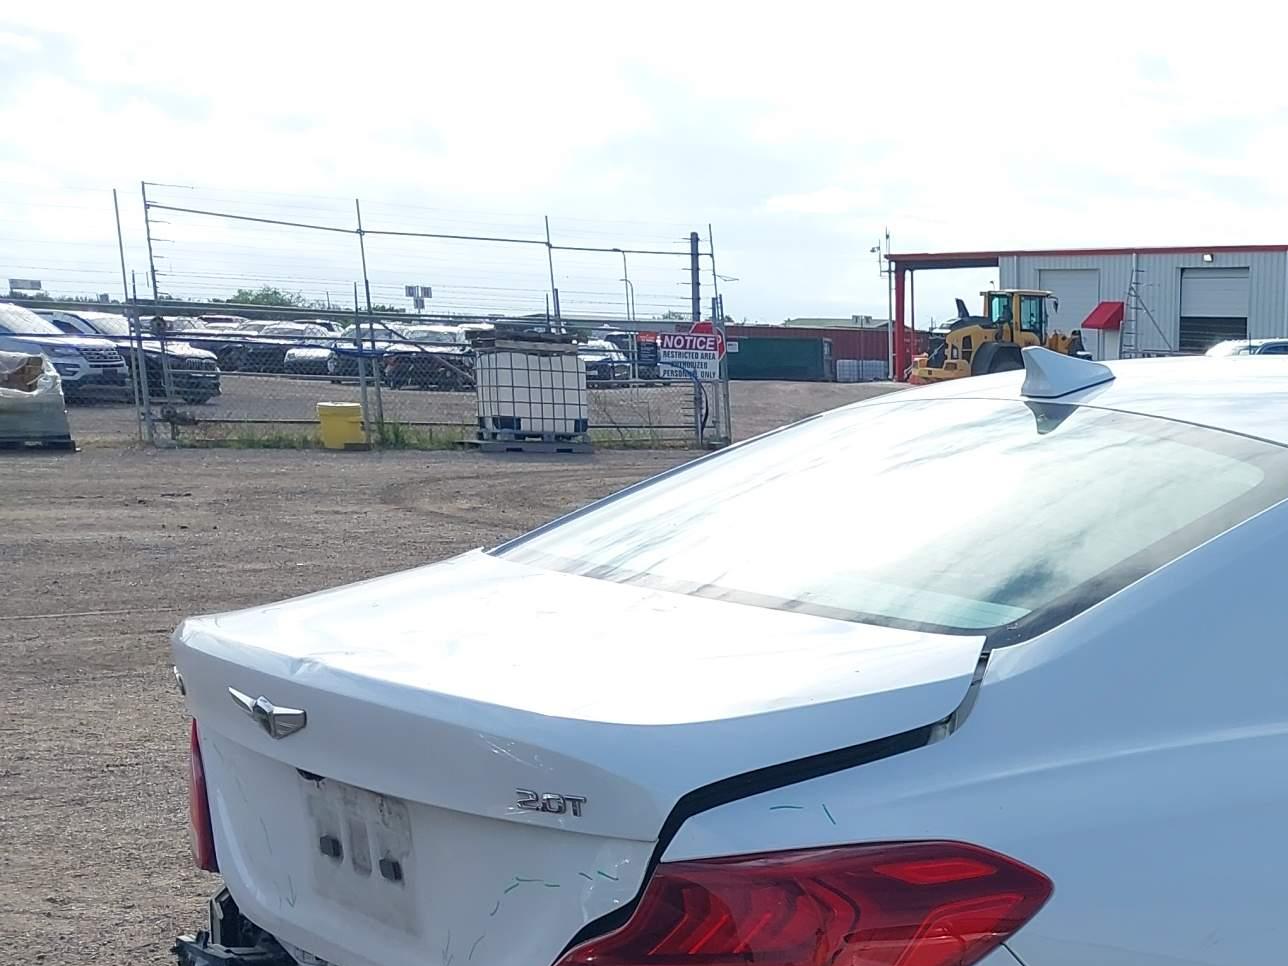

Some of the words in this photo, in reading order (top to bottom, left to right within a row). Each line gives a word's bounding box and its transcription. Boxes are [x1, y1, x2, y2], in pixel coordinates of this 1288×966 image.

[663, 335, 715, 350] NOTICE
[663, 351, 698, 360] RESTRICTED
[700, 352, 716, 360] AREA
[700, 371, 716, 379] ONLY
[516, 788, 587, 817] 2.0T
